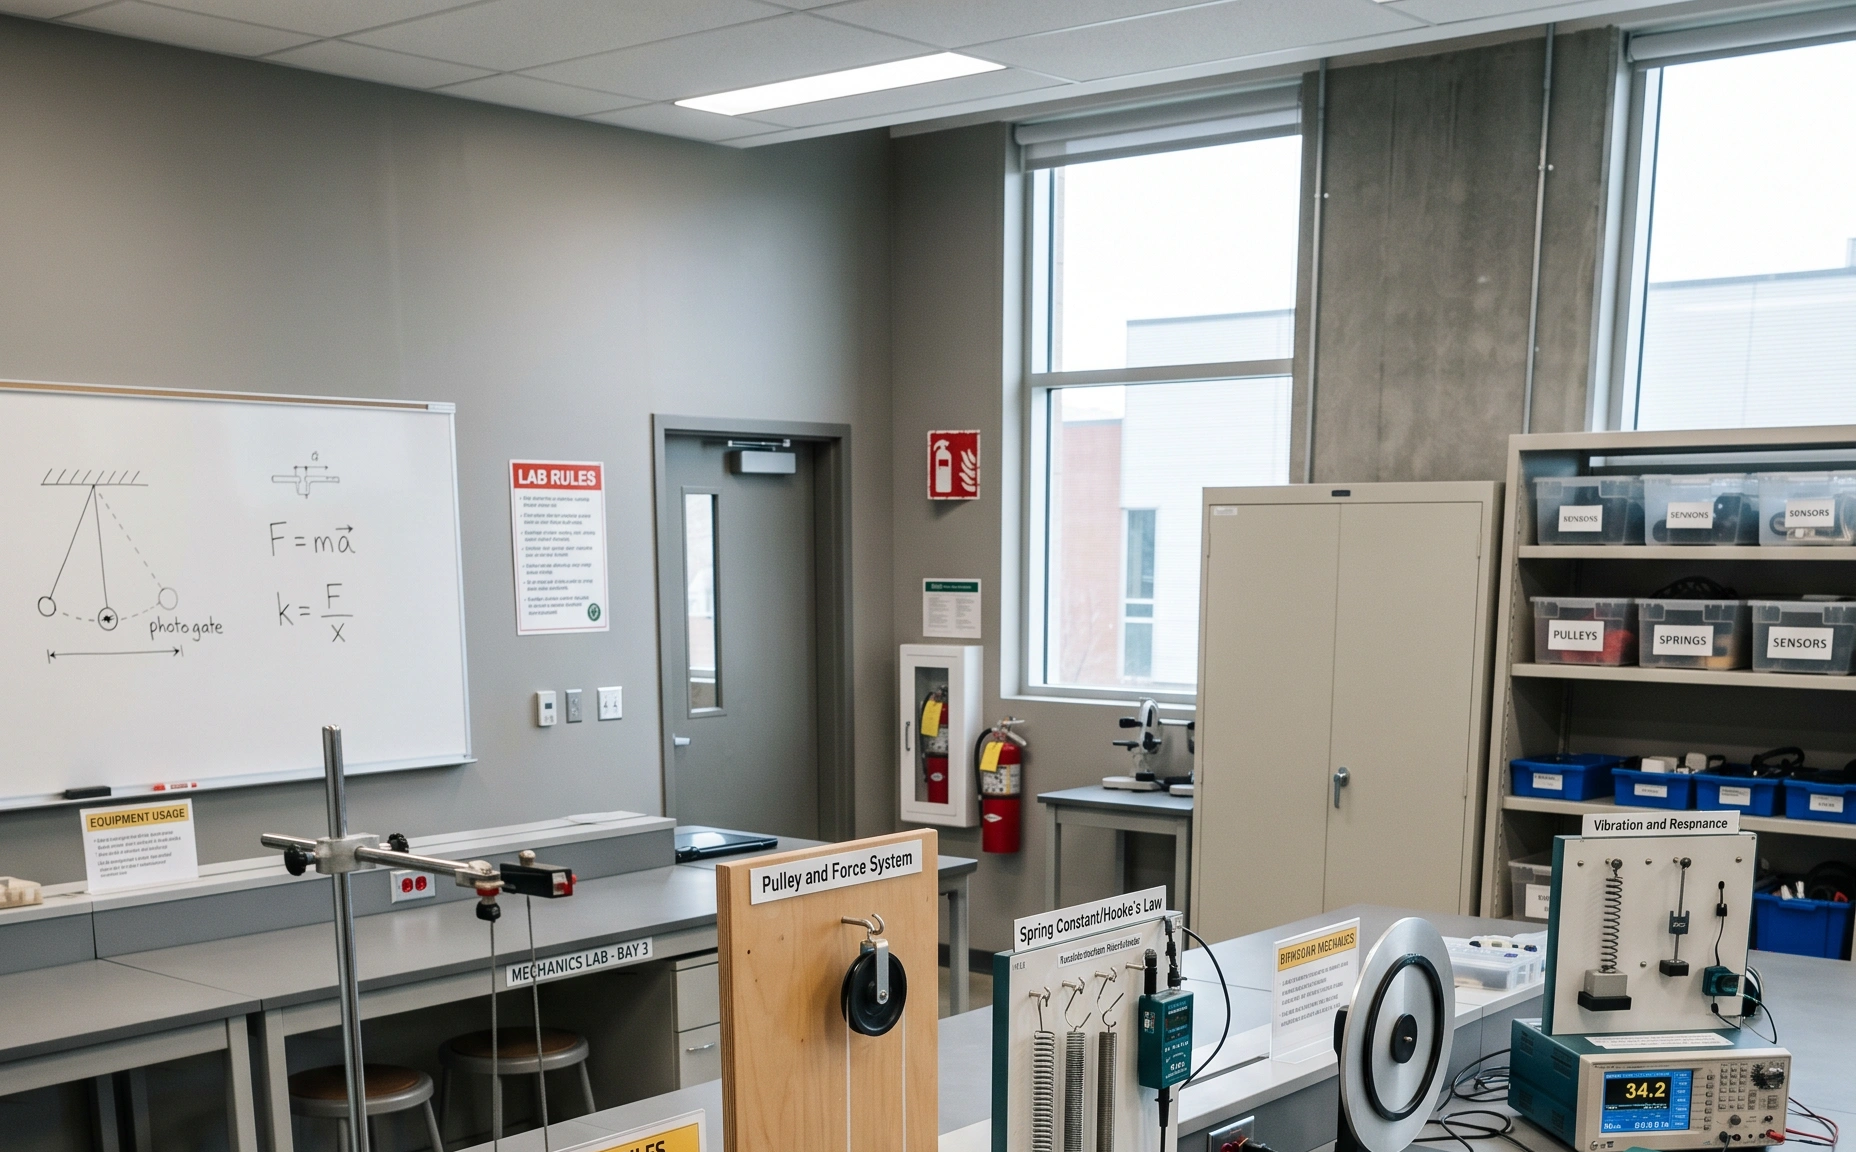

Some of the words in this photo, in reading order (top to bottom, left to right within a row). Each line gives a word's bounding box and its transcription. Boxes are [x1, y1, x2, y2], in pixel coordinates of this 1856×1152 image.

[518, 469, 547, 485] LAB
[551, 469, 596, 486] RULES
[1553, 630, 1598, 641] PULLEYS
[1659, 635, 1707, 646] SPRINGS
[1773, 637, 1827, 649] SENSORS
[90, 812, 150, 828] EQUIPMENT
[152, 808, 185, 821] USAGE
[1594, 819, 1643, 832] Vibration
[1646, 819, 1667, 830] and
[762, 871, 802, 893] Pulley
[805, 864, 828, 885] and
[832, 862, 866, 880] Force
[870, 853, 913, 876] System
[1020, 923, 1054, 945] Spring
[1056, 901, 1141, 934] Constant/Hooke's
[1144, 897, 1163, 912] Law
[512, 955, 583, 982] MECHANICS
[586, 950, 608, 968] LAB
[617, 943, 640, 960] BAY
[642, 941, 649, 956] 3
[1625, 1081, 1666, 1099] 34.2
